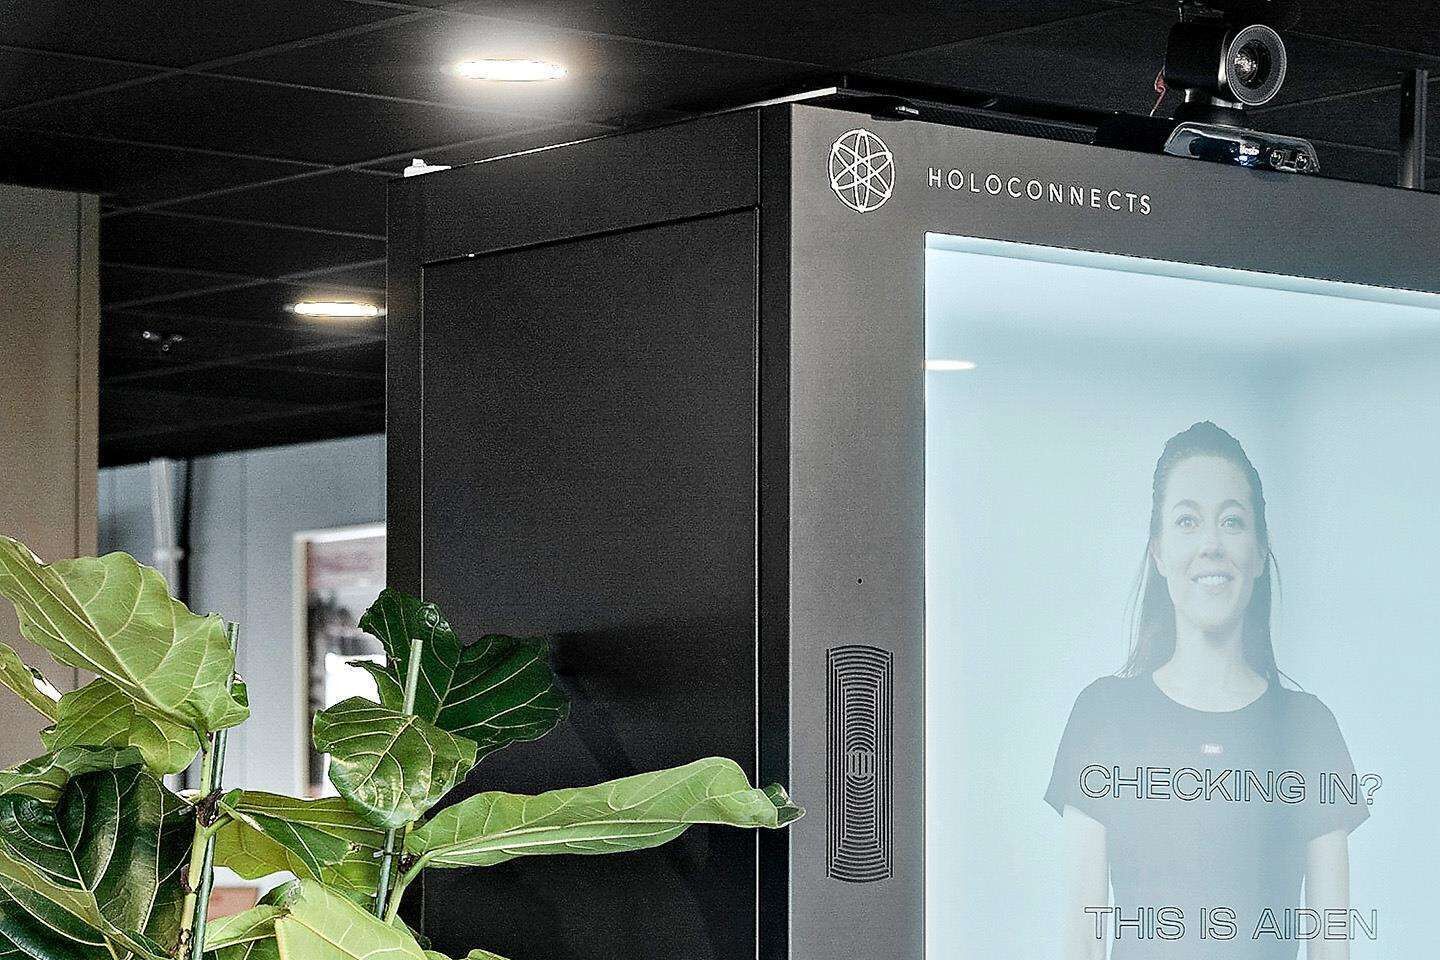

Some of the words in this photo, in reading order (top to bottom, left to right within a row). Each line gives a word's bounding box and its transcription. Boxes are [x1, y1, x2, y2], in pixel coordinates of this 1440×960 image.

[927, 167, 1152, 216] HOLOCONNECTS
[1079, 764, 1306, 804] CHECKING
[1319, 771, 1383, 805] IN?
[1084, 906, 1186, 940] THIS
[1200, 906, 1238, 940] IS
[1252, 908, 1378, 940] AIDEN
